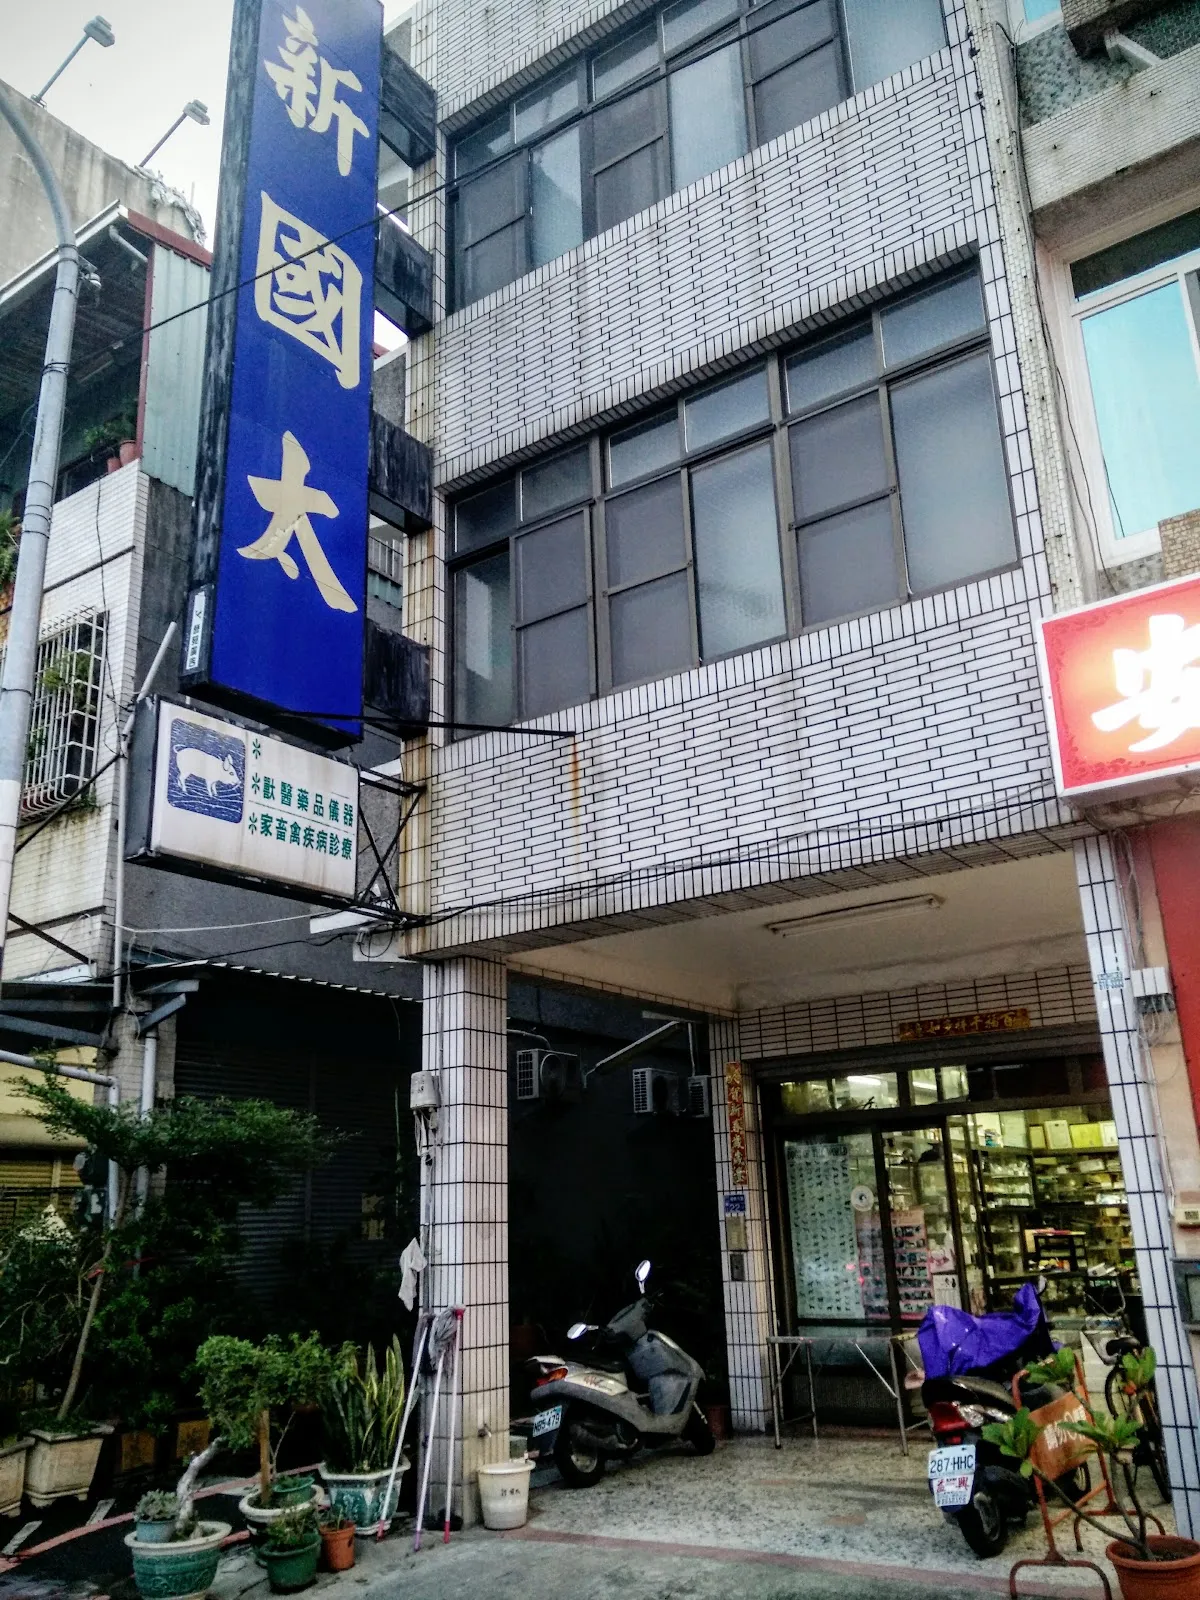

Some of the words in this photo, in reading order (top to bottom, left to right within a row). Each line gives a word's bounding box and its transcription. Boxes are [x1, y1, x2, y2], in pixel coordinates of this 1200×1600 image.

[237, 5, 370, 613] 新國太
[262, 775, 354, 828] 獸醫藥品儀器
[260, 813, 353, 860] 家畜禽疾病診療
[930, 1454, 974, 1474] 287-HHC
